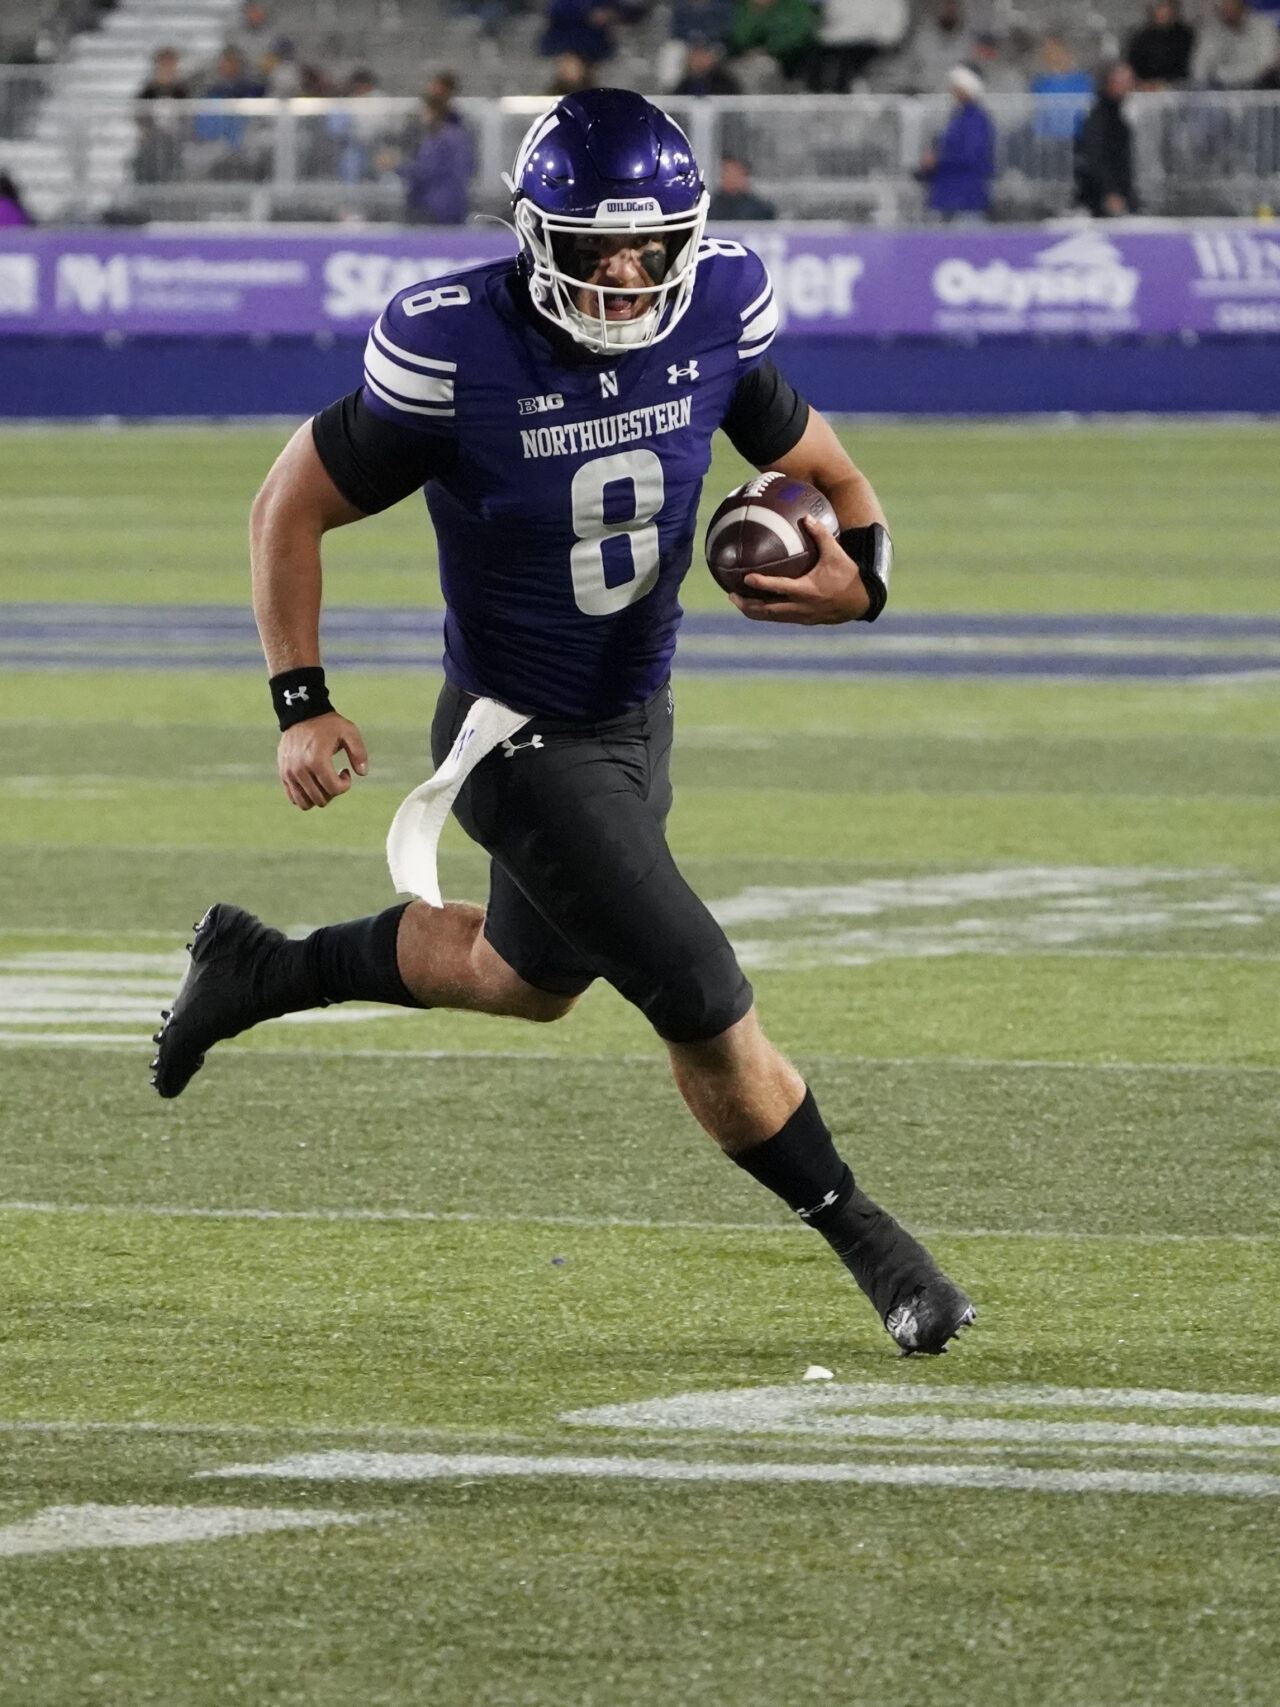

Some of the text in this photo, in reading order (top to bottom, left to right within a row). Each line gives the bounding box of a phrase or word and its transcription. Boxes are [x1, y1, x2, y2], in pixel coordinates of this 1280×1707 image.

[606, 201, 655, 213] WILDCATS
[402, 285, 471, 317] 8
[598, 371, 619, 398] N
[520, 395, 692, 459] NORTHWESTERN
[570, 449, 665, 616] 8
